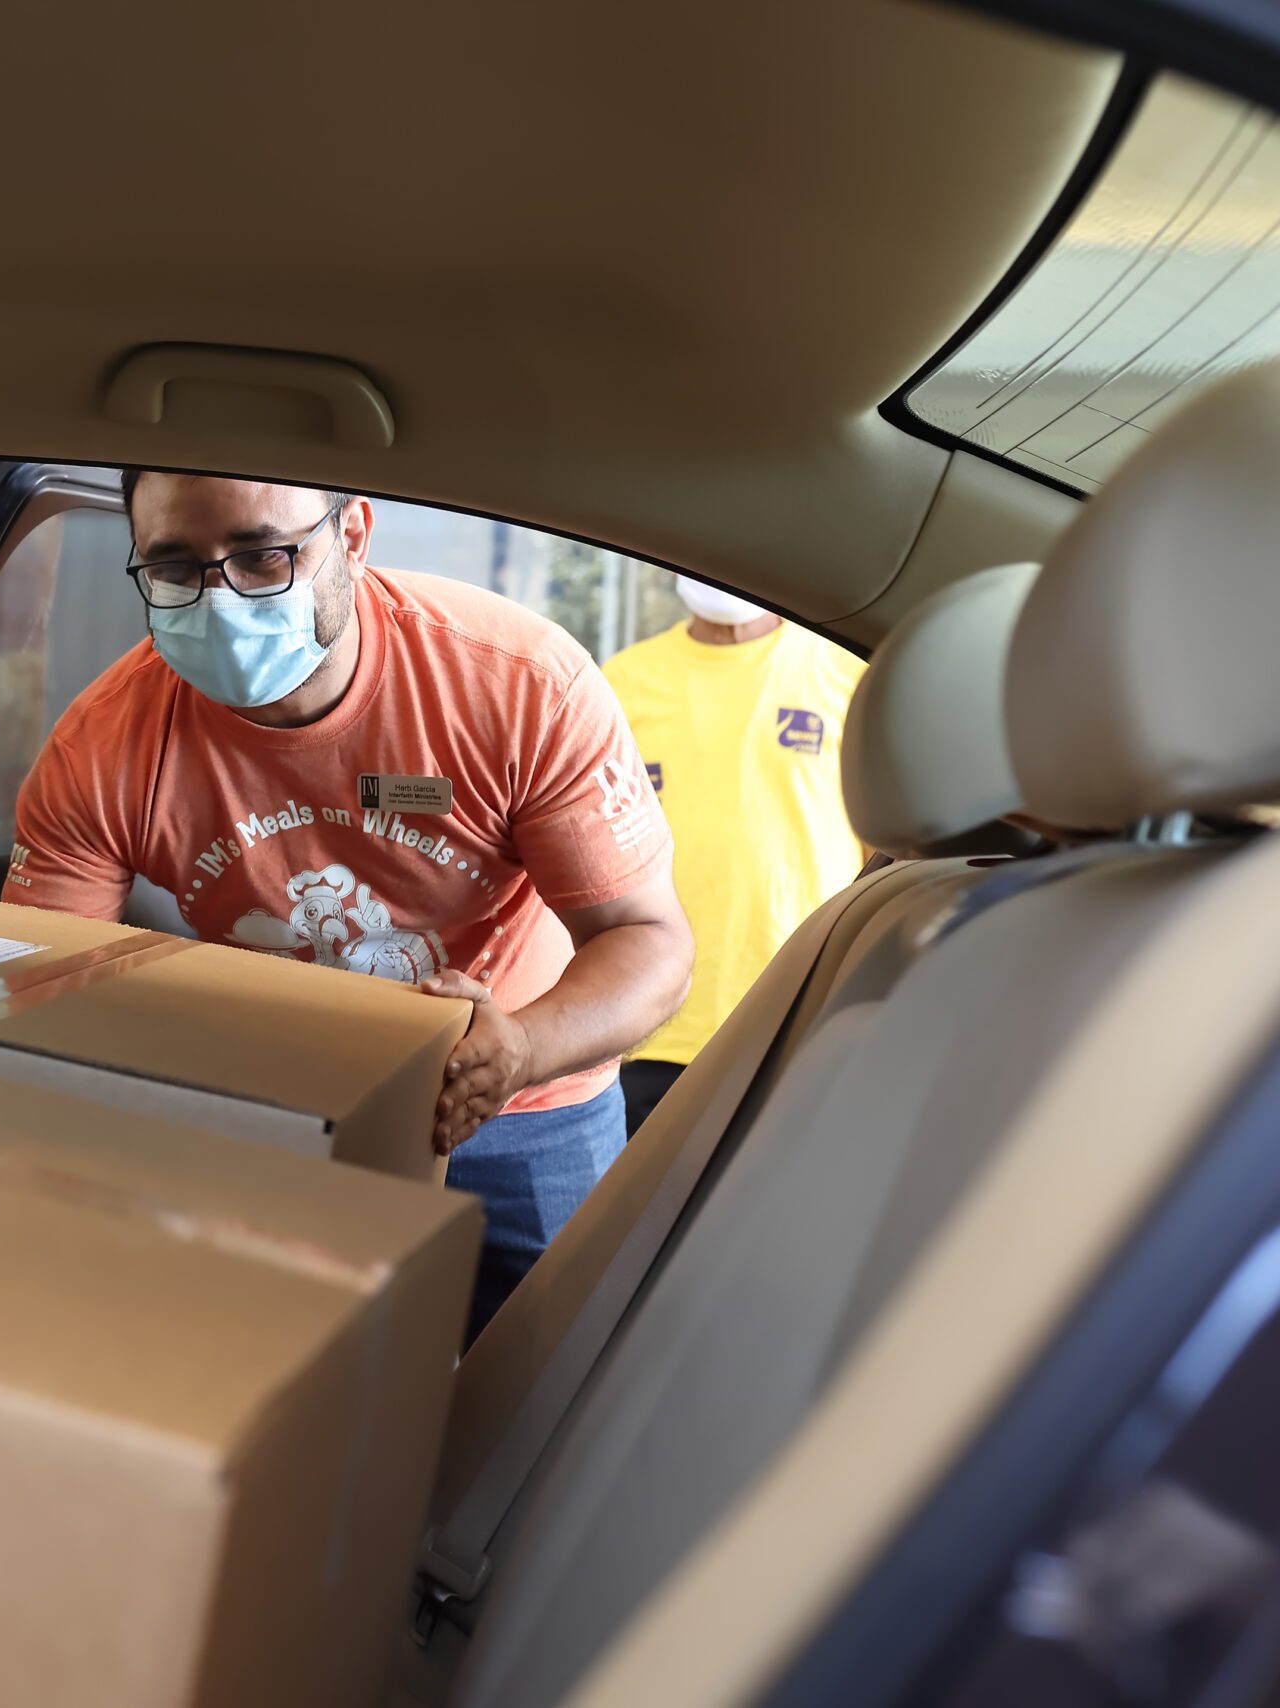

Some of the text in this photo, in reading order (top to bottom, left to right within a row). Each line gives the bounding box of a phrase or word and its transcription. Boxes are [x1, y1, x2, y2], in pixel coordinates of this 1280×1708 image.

[363, 778, 378, 797] IM
[394, 784, 436, 793] Herb Garcia
[388, 791, 413, 799] Interfaith
[195, 799, 455, 879] IM's Meals on Wheels
